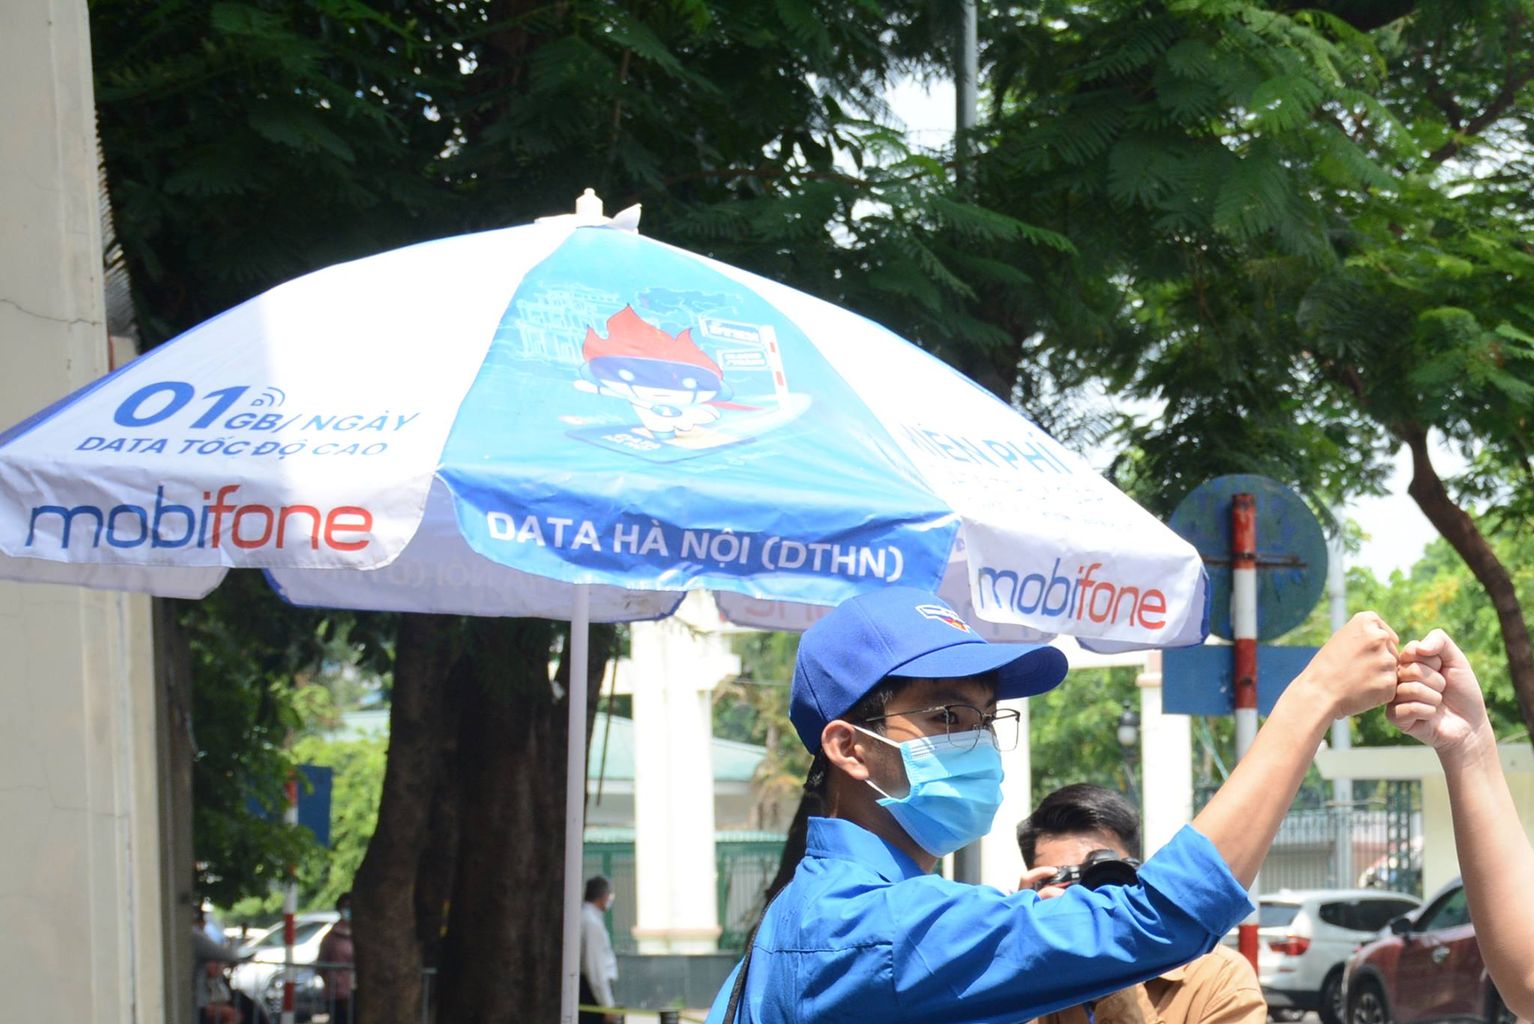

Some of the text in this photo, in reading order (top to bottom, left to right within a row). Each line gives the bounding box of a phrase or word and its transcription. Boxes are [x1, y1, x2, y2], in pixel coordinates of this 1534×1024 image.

[113, 381, 251, 429] 01
[74, 435, 388, 461] DATA TỐC ĐỘ CAO
[25, 484, 373, 551] mobifone
[486, 511, 904, 583] DATA HÀ NỘI (DTHN)
[977, 557, 1167, 630] mobifone
